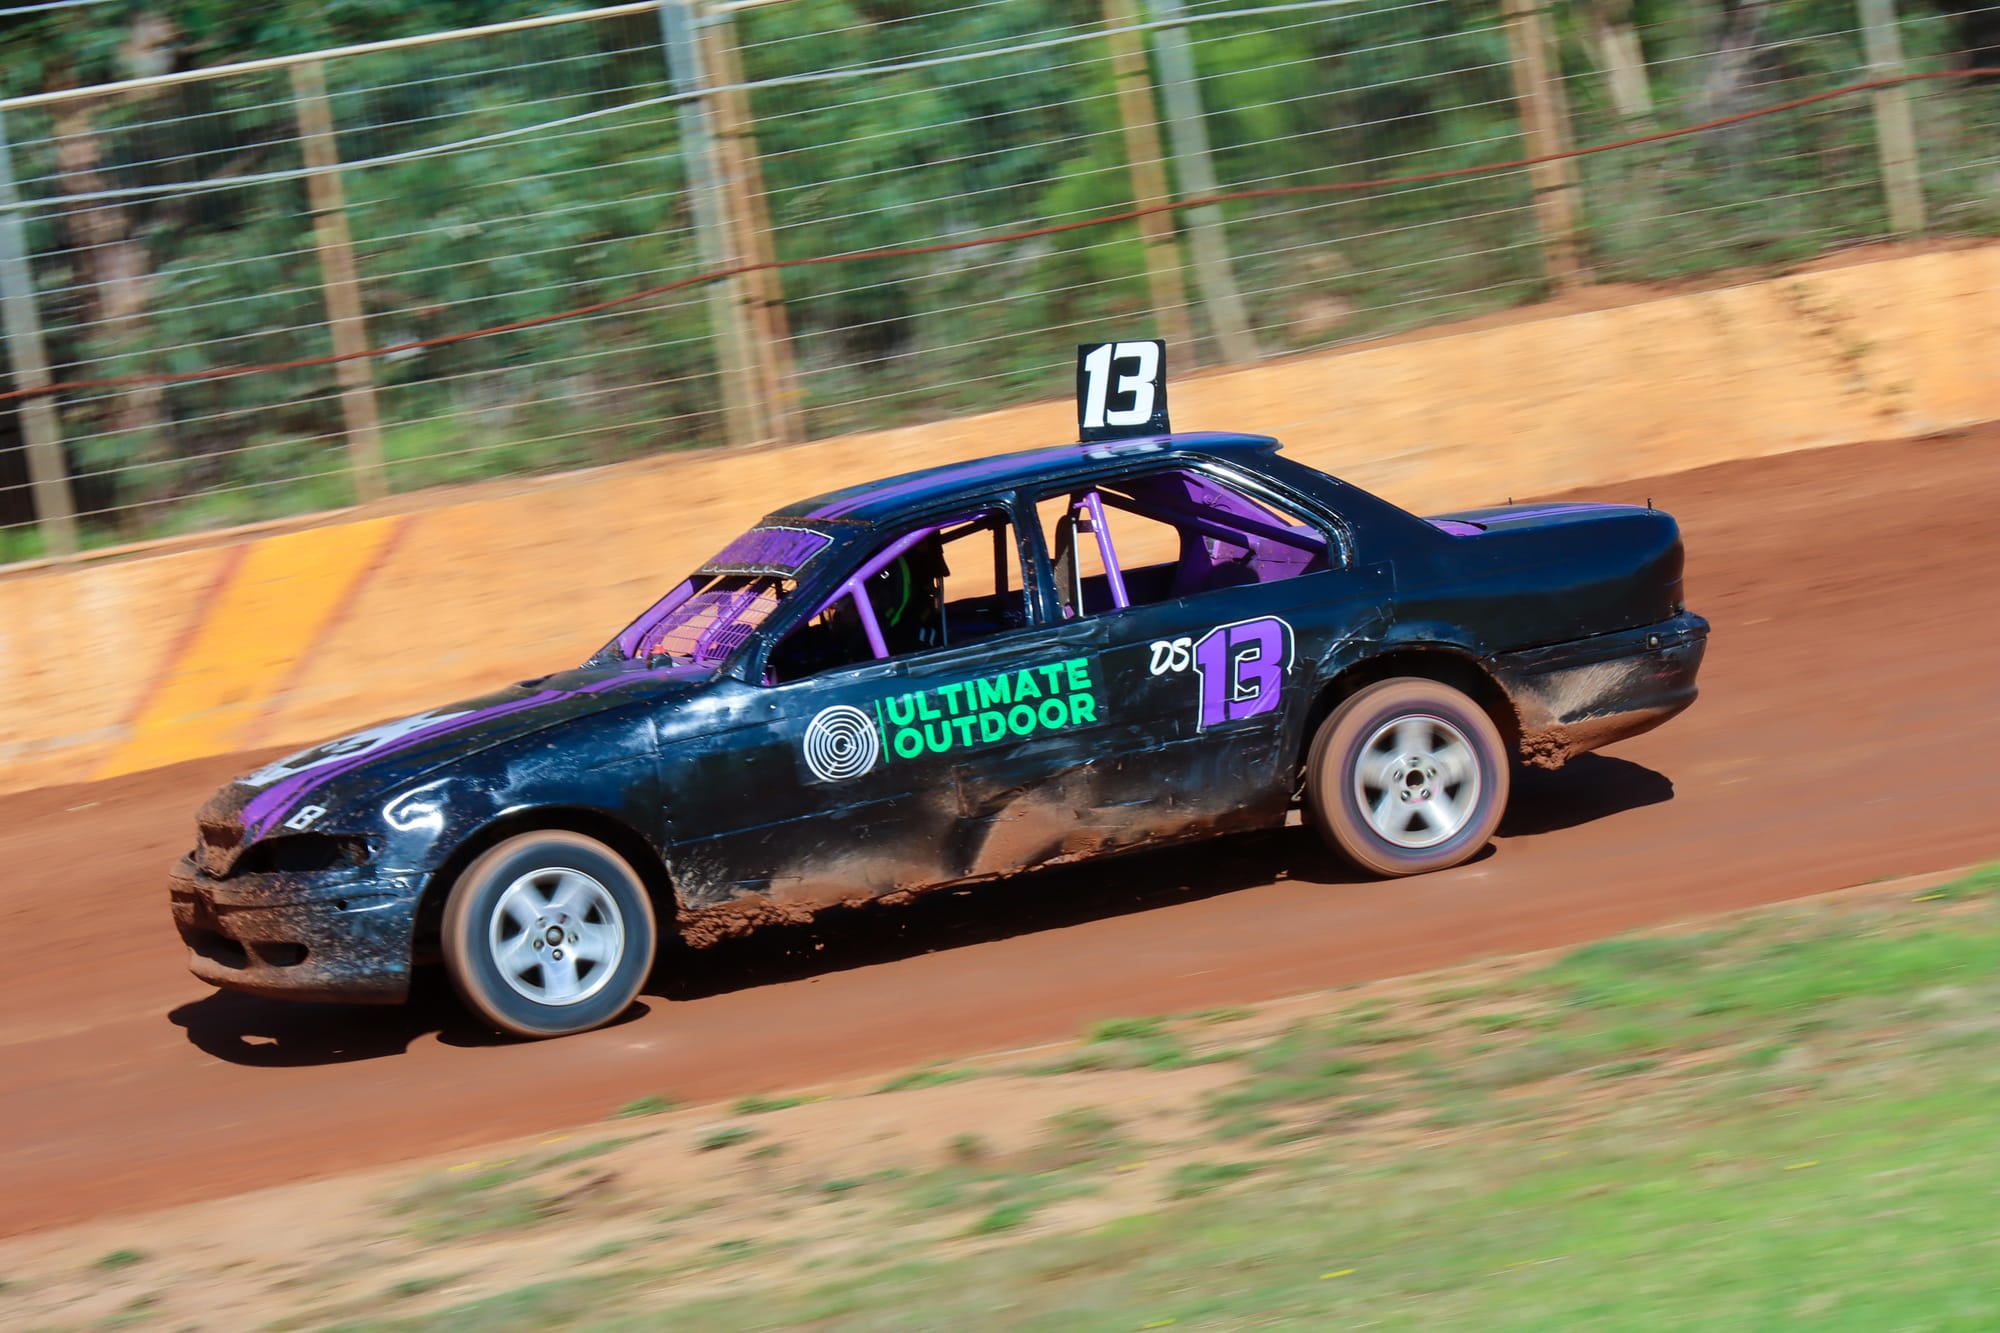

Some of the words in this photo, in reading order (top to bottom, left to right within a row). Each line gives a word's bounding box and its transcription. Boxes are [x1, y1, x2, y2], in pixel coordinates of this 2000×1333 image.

[1083, 341, 1159, 428] 13
[885, 657, 1092, 726] ULTIMATE
[1149, 637, 1192, 676] DS
[1193, 617, 1295, 733] 13
[893, 692, 1097, 759] OUTDOOR
